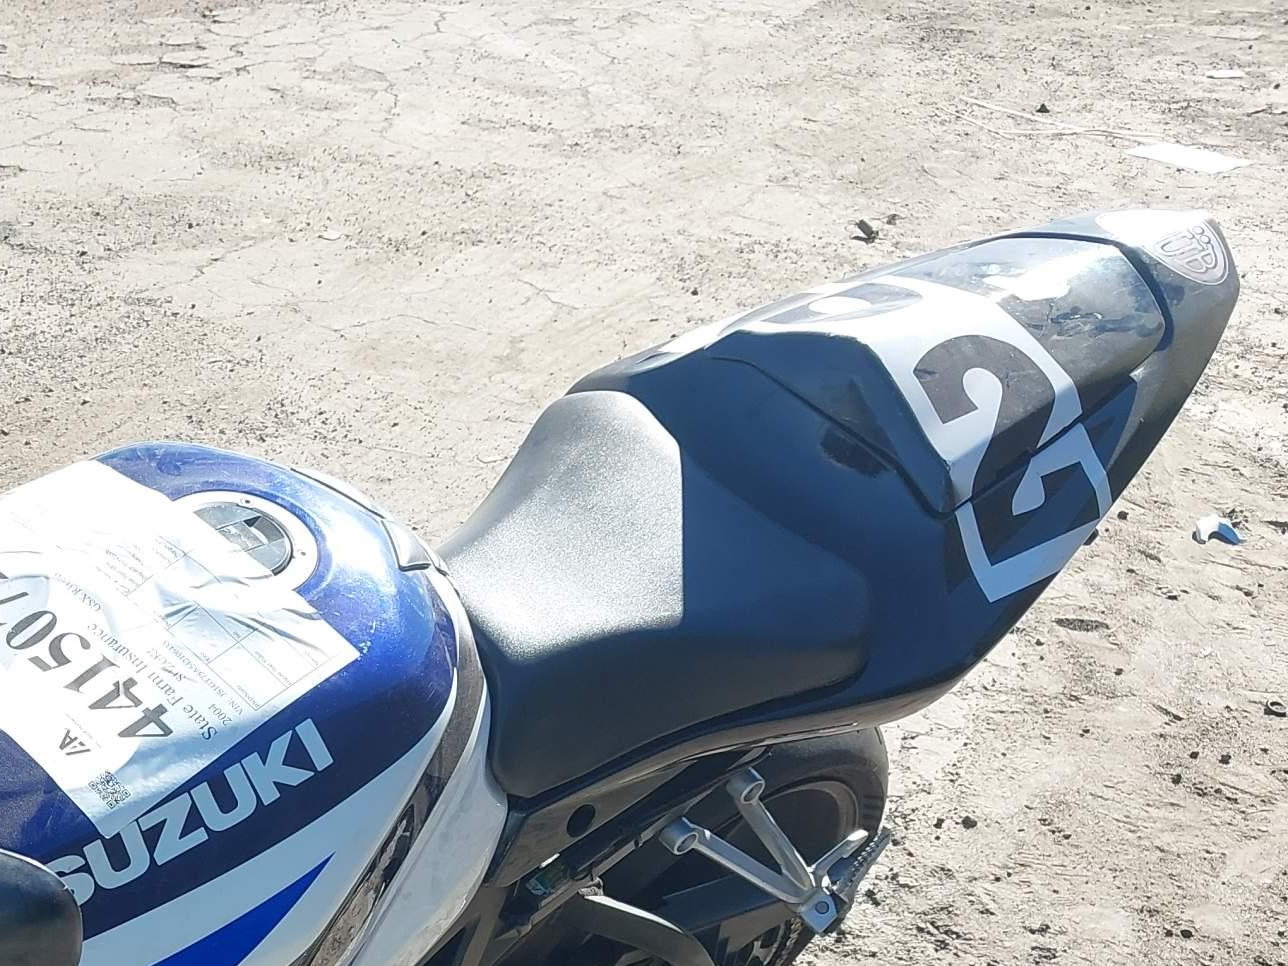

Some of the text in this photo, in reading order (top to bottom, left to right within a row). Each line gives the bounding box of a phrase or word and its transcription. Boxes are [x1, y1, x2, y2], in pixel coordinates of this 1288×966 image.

[144, 671, 185, 706] Farm
[180, 703, 219, 741] State
[207, 702, 233, 726] 2004
[49, 718, 334, 904] SUZUKI
